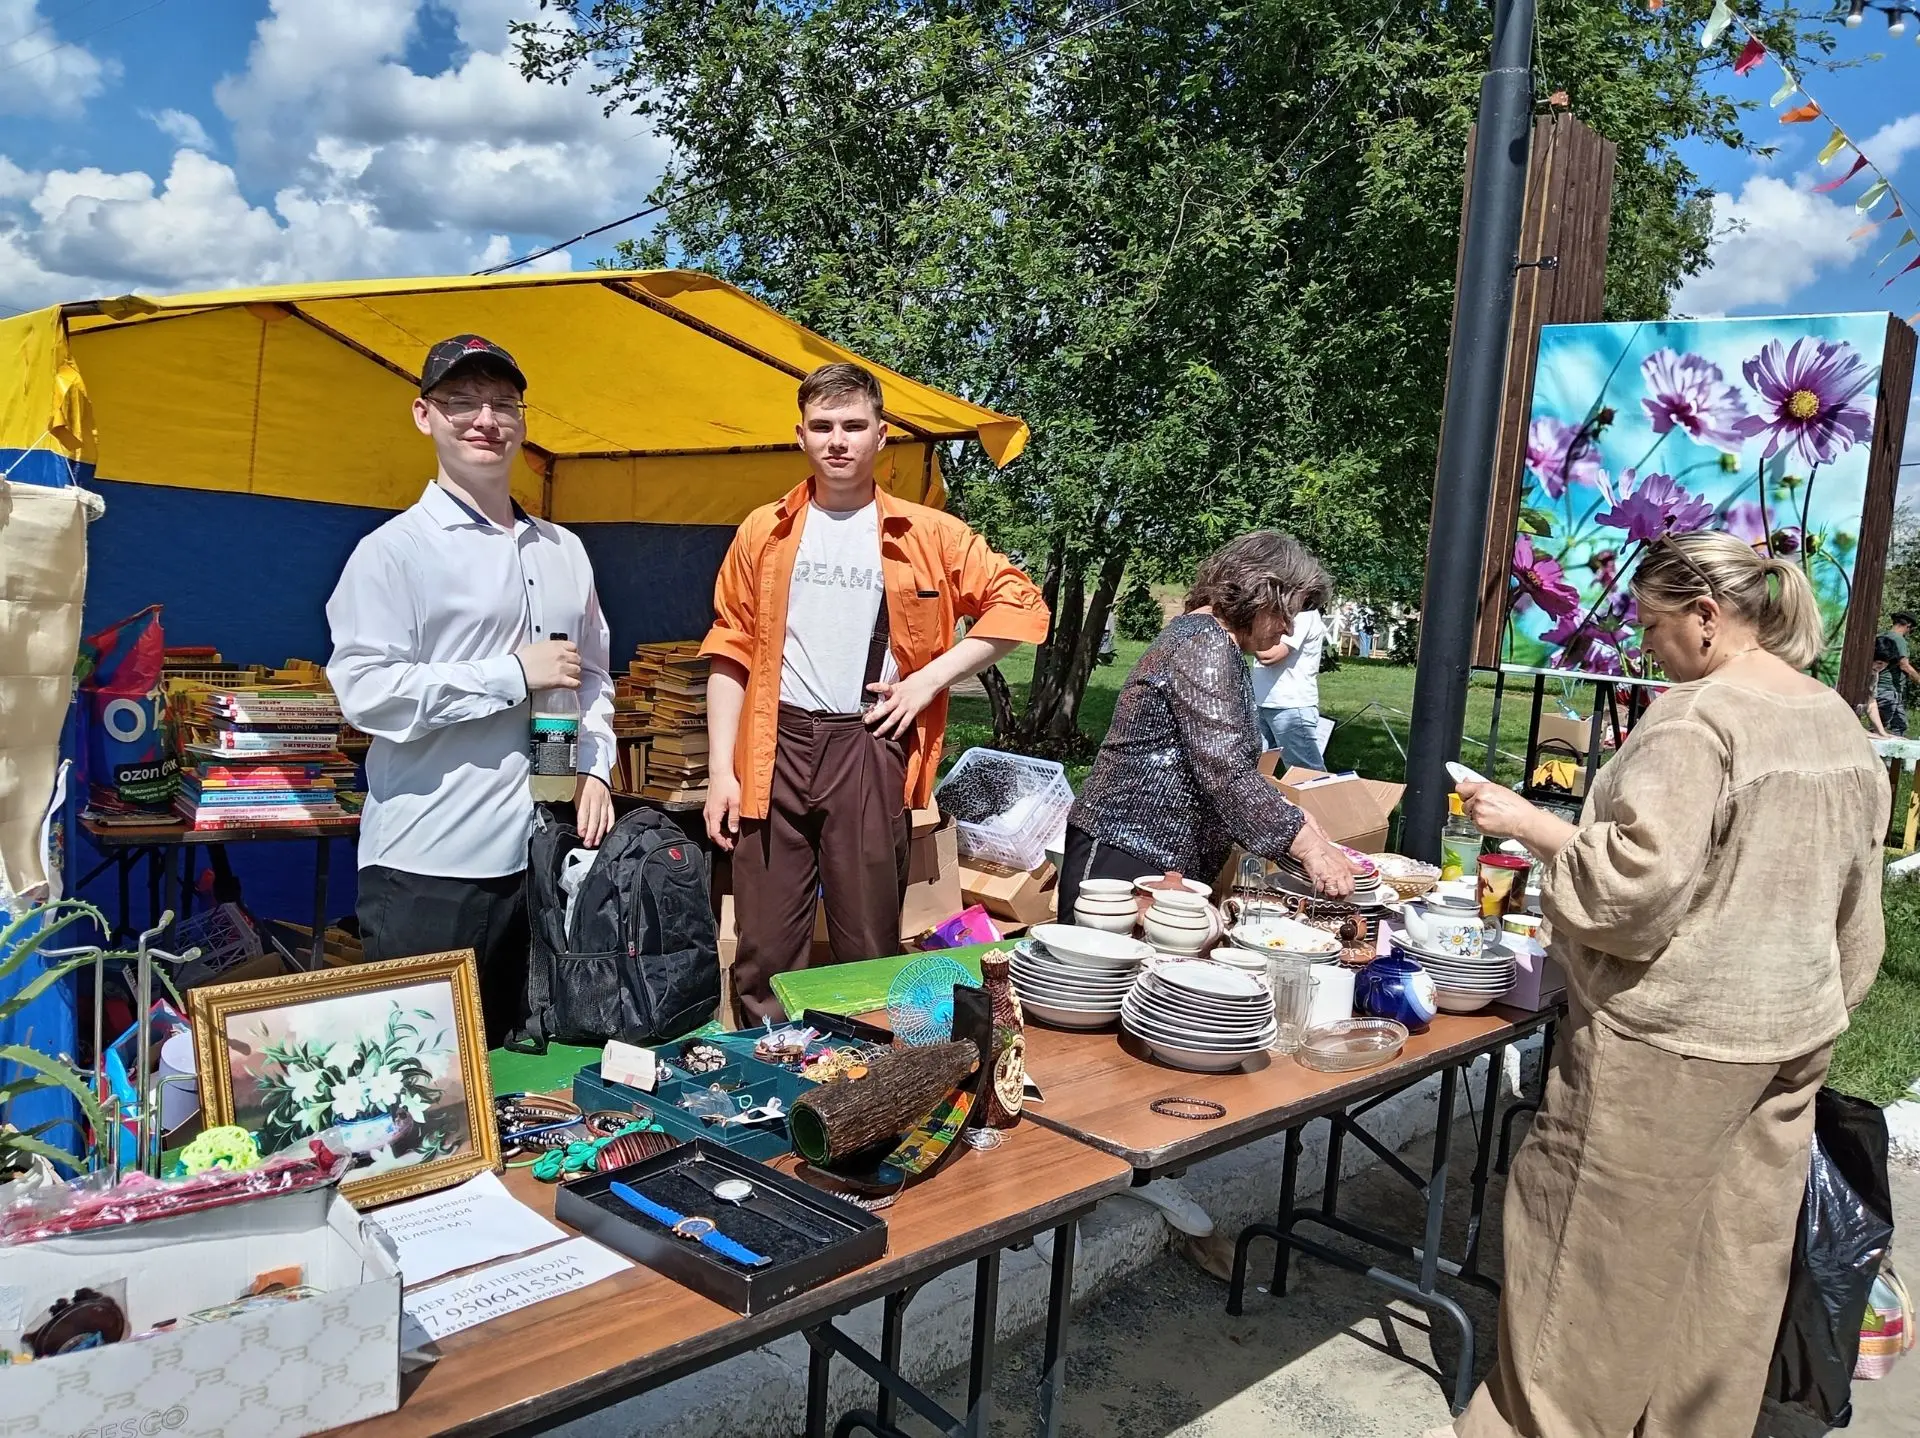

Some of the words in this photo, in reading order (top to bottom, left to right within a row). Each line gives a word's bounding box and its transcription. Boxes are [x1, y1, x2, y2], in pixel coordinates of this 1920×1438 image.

[418, 1193, 483, 1213] перевода
[445, 1266, 585, 1320] 9506415504
[449, 1283, 486, 1303] ДЛЯ
[488, 1254, 579, 1288] ПЕРЕВОДА
